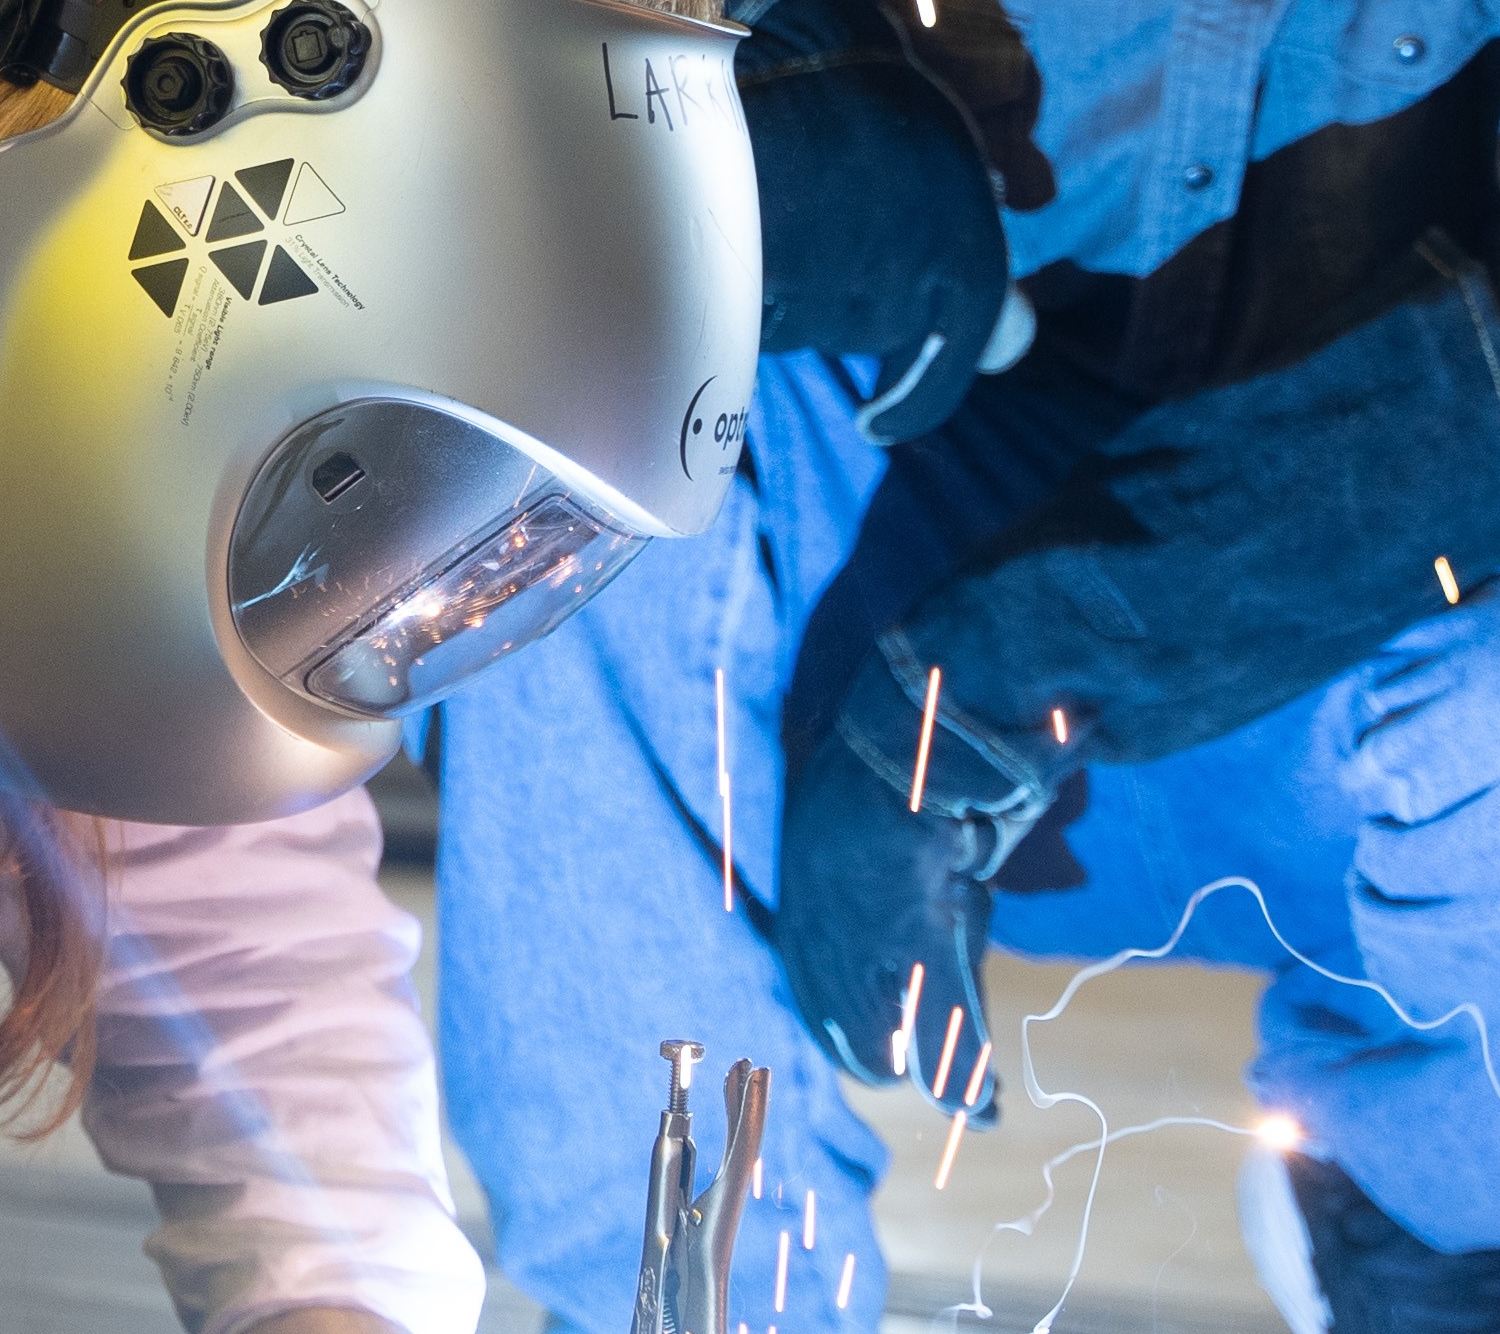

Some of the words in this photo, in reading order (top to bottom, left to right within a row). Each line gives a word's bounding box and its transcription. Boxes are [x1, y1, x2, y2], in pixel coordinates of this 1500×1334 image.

[285, 236, 299, 253] 31%
[298, 252, 314, 269] Light
[313, 267, 350, 307] Transmission
[295, 234, 319, 259] Crystal
[316, 258, 332, 275] Lens
[331, 274, 365, 310] Technology
[219, 296, 233, 323] Visible
[212, 324, 224, 346] Light
[205, 347, 216, 370] range
